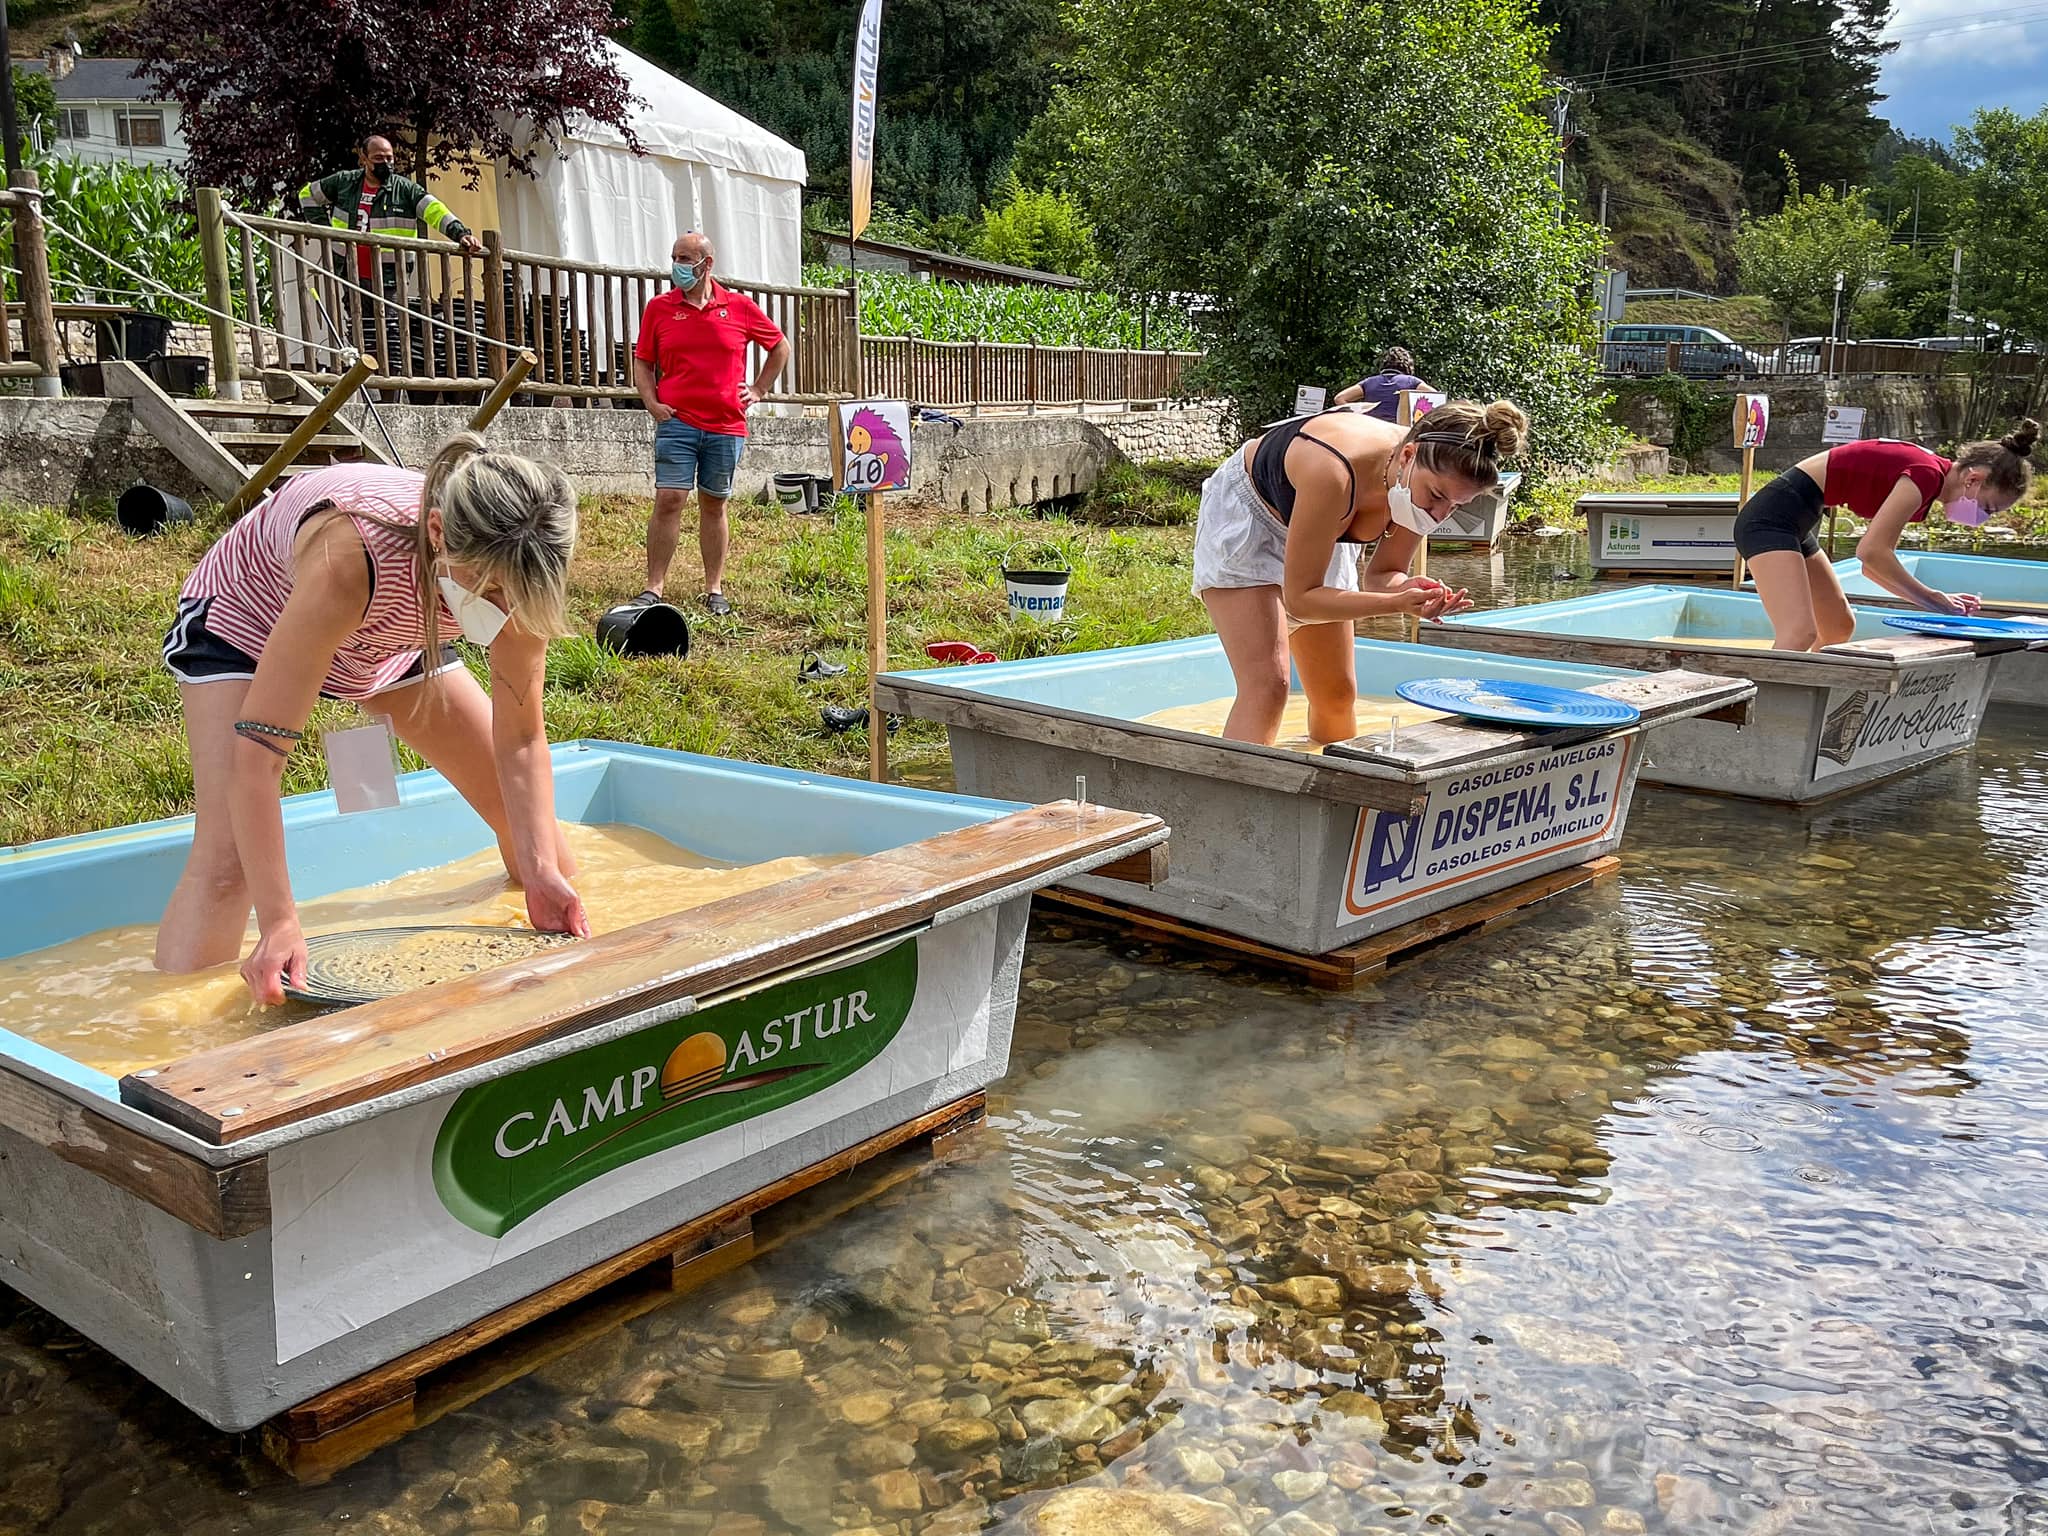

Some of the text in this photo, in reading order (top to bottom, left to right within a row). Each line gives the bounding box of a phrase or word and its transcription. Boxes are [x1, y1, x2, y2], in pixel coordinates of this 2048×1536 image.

[857, 14, 877, 160] OROVALLE
[851, 459, 882, 484] 10
[1607, 541, 1641, 551] Asturias
[1856, 693, 1969, 749] Navelgas
[1447, 742, 1616, 797] GASOLEOS NAVELGAS
[1432, 770, 1608, 851] DISPENA, S.L.
[1425, 813, 1605, 876] GASOLEOS A DOMICILIO
